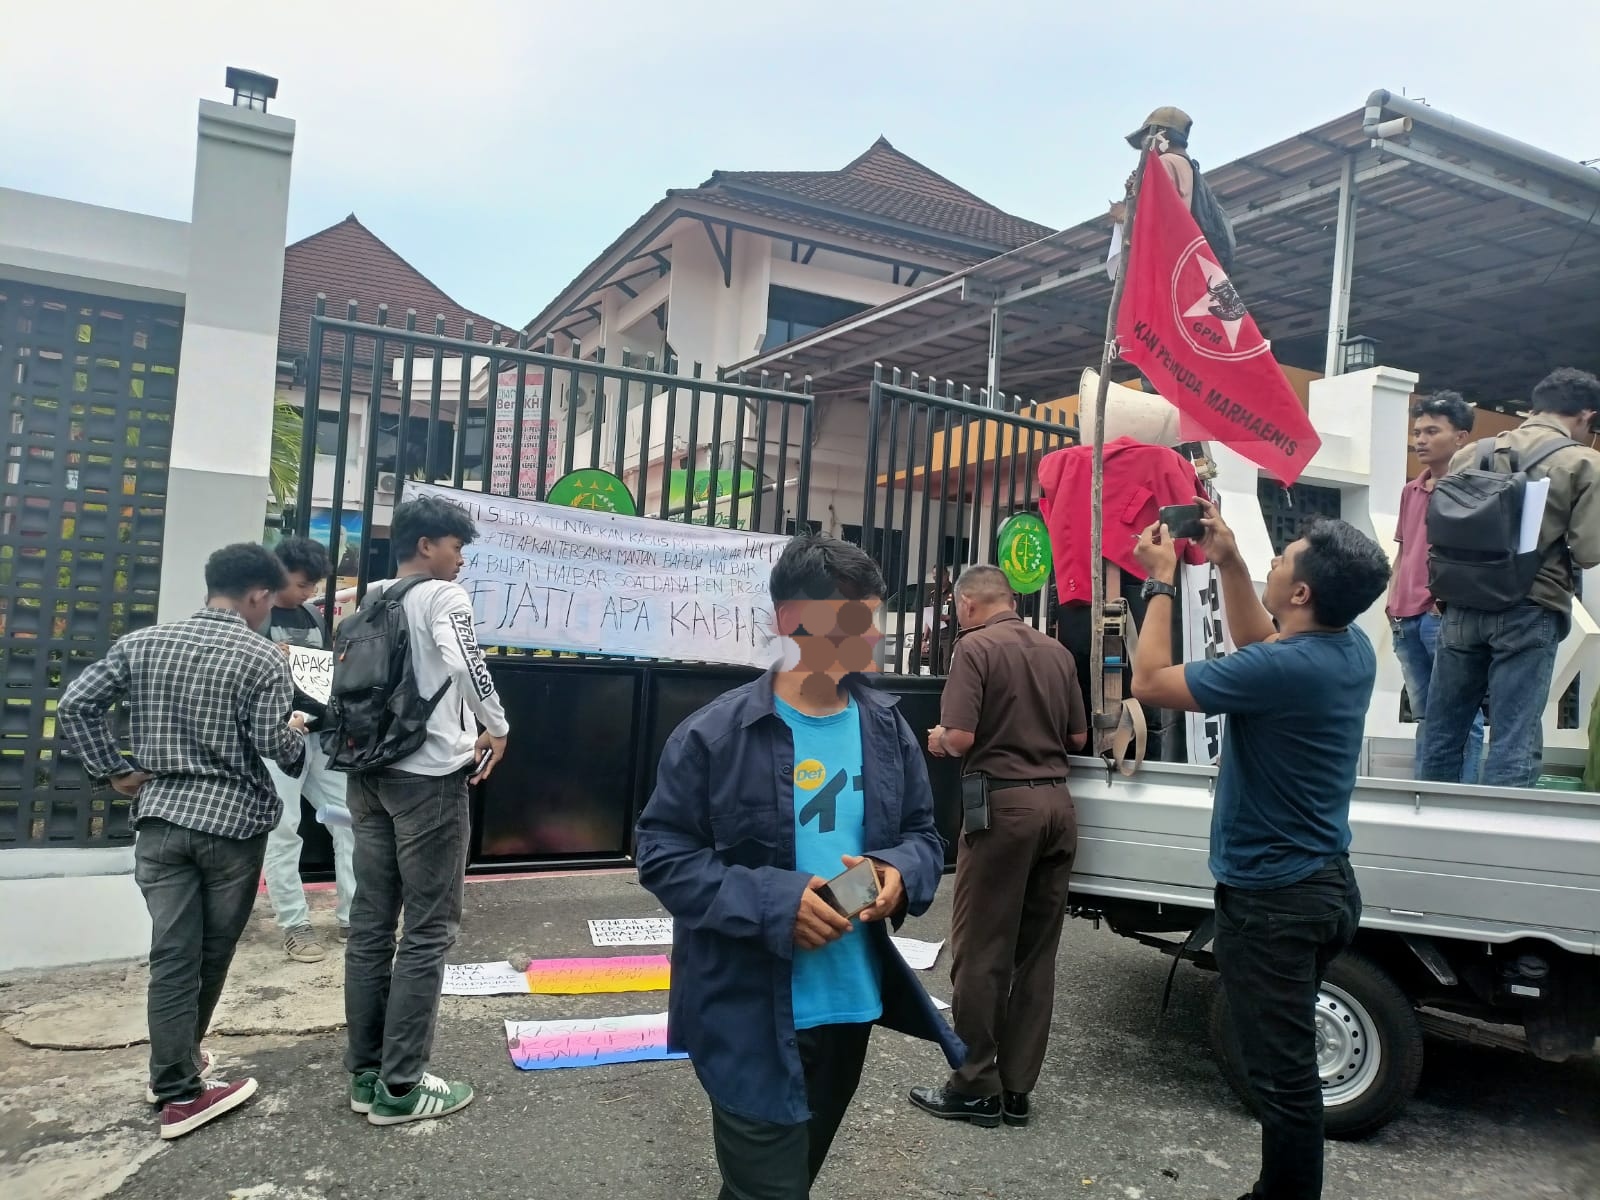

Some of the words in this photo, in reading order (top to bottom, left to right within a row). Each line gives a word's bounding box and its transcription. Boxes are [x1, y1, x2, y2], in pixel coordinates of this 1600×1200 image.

[1193, 322, 1223, 345] GPM
[1156, 343, 1203, 395] PEMUDA
[1204, 388, 1298, 457] MARHAENIS
[486, 506, 542, 528] SEGERA
[487, 554, 539, 581] BUPATI
[547, 564, 610, 588] HALBAR
[497, 532, 556, 558] TETAPKAN
[616, 550, 656, 566] MANTAN
[663, 551, 703, 571] BAPEDA
[709, 560, 757, 577] HALBAR
[463, 577, 575, 630] EJATI
[600, 596, 650, 632] APA
[670, 600, 774, 647] KABAR
